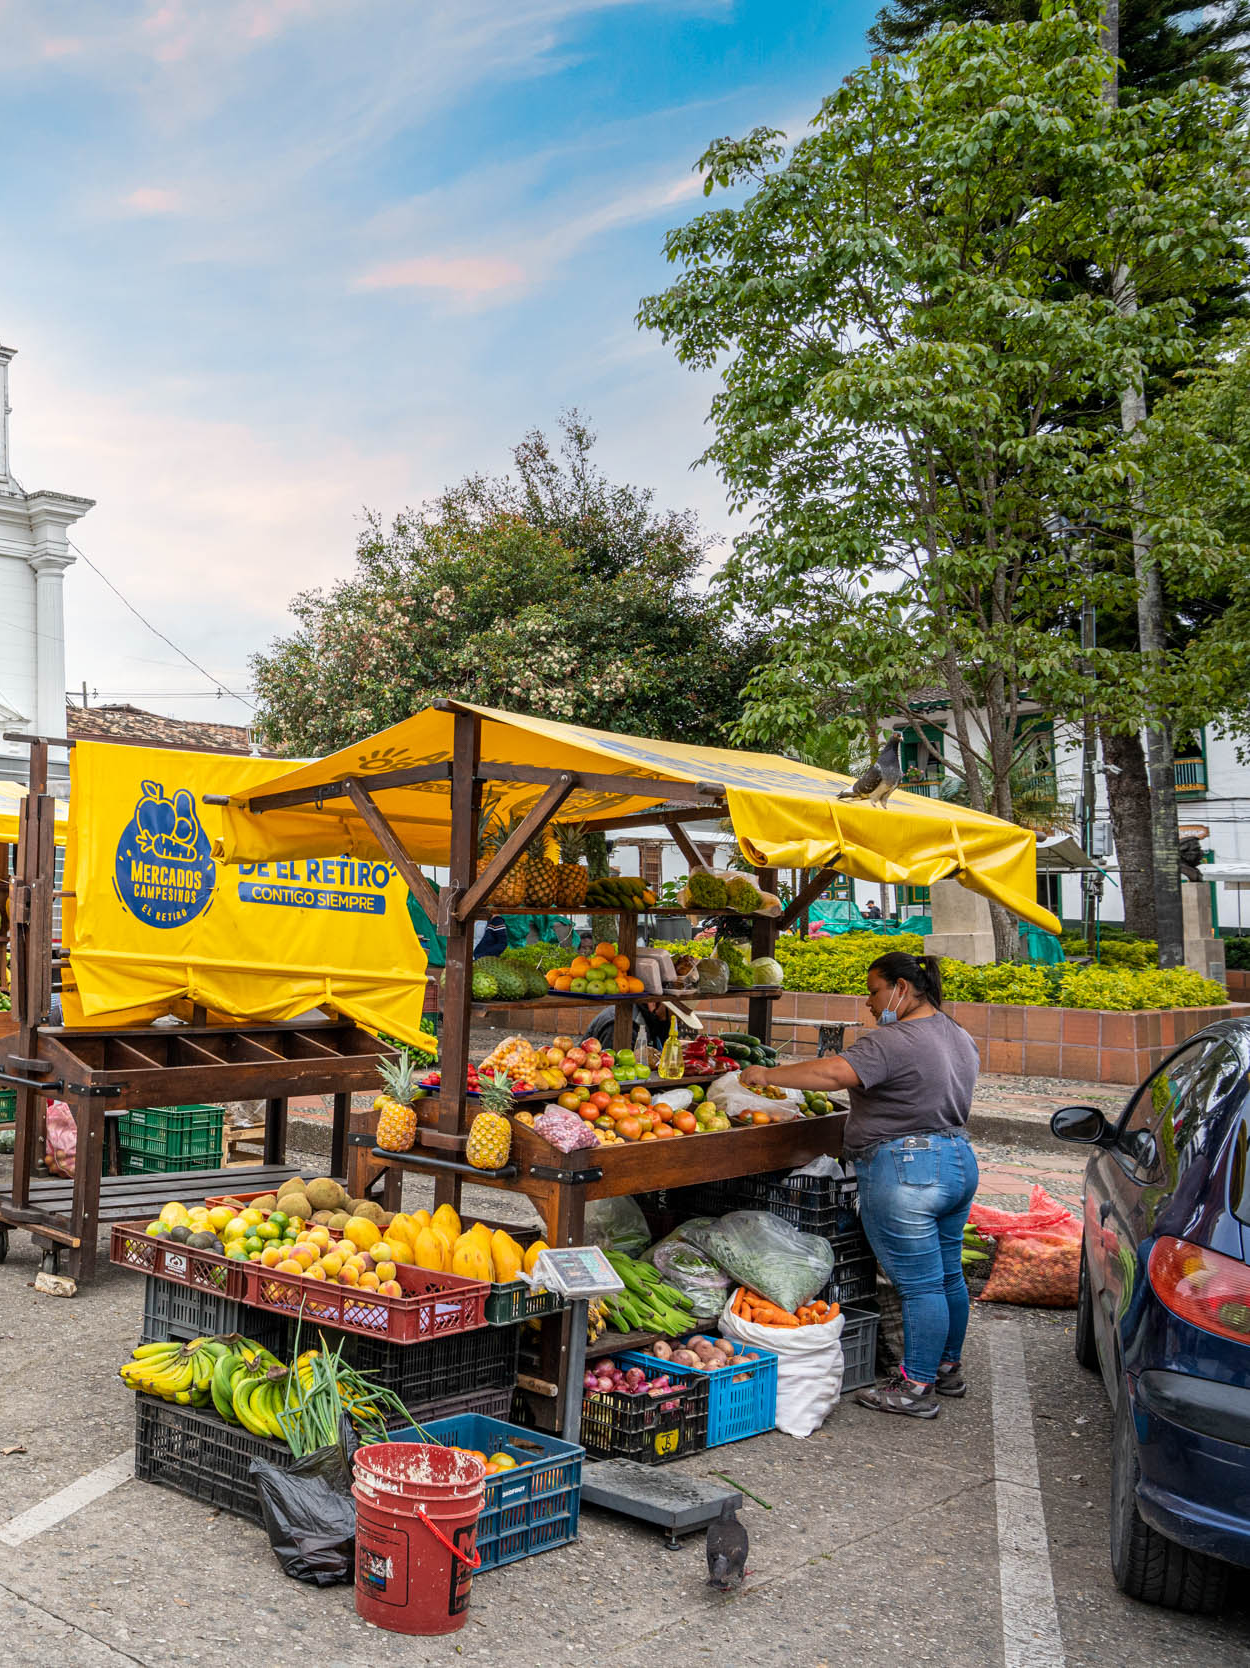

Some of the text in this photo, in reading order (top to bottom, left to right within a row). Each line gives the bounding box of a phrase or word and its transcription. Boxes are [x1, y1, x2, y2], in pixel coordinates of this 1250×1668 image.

[131, 860, 202, 890] MERCADOS
[273, 861, 300, 881] EL
[306, 860, 390, 889] RETIRO
[133, 883, 197, 904] CAMPESINOS
[251, 886, 375, 911] CONTIGO SIEMPRE
[141, 903, 188, 922] EL RETIRO
